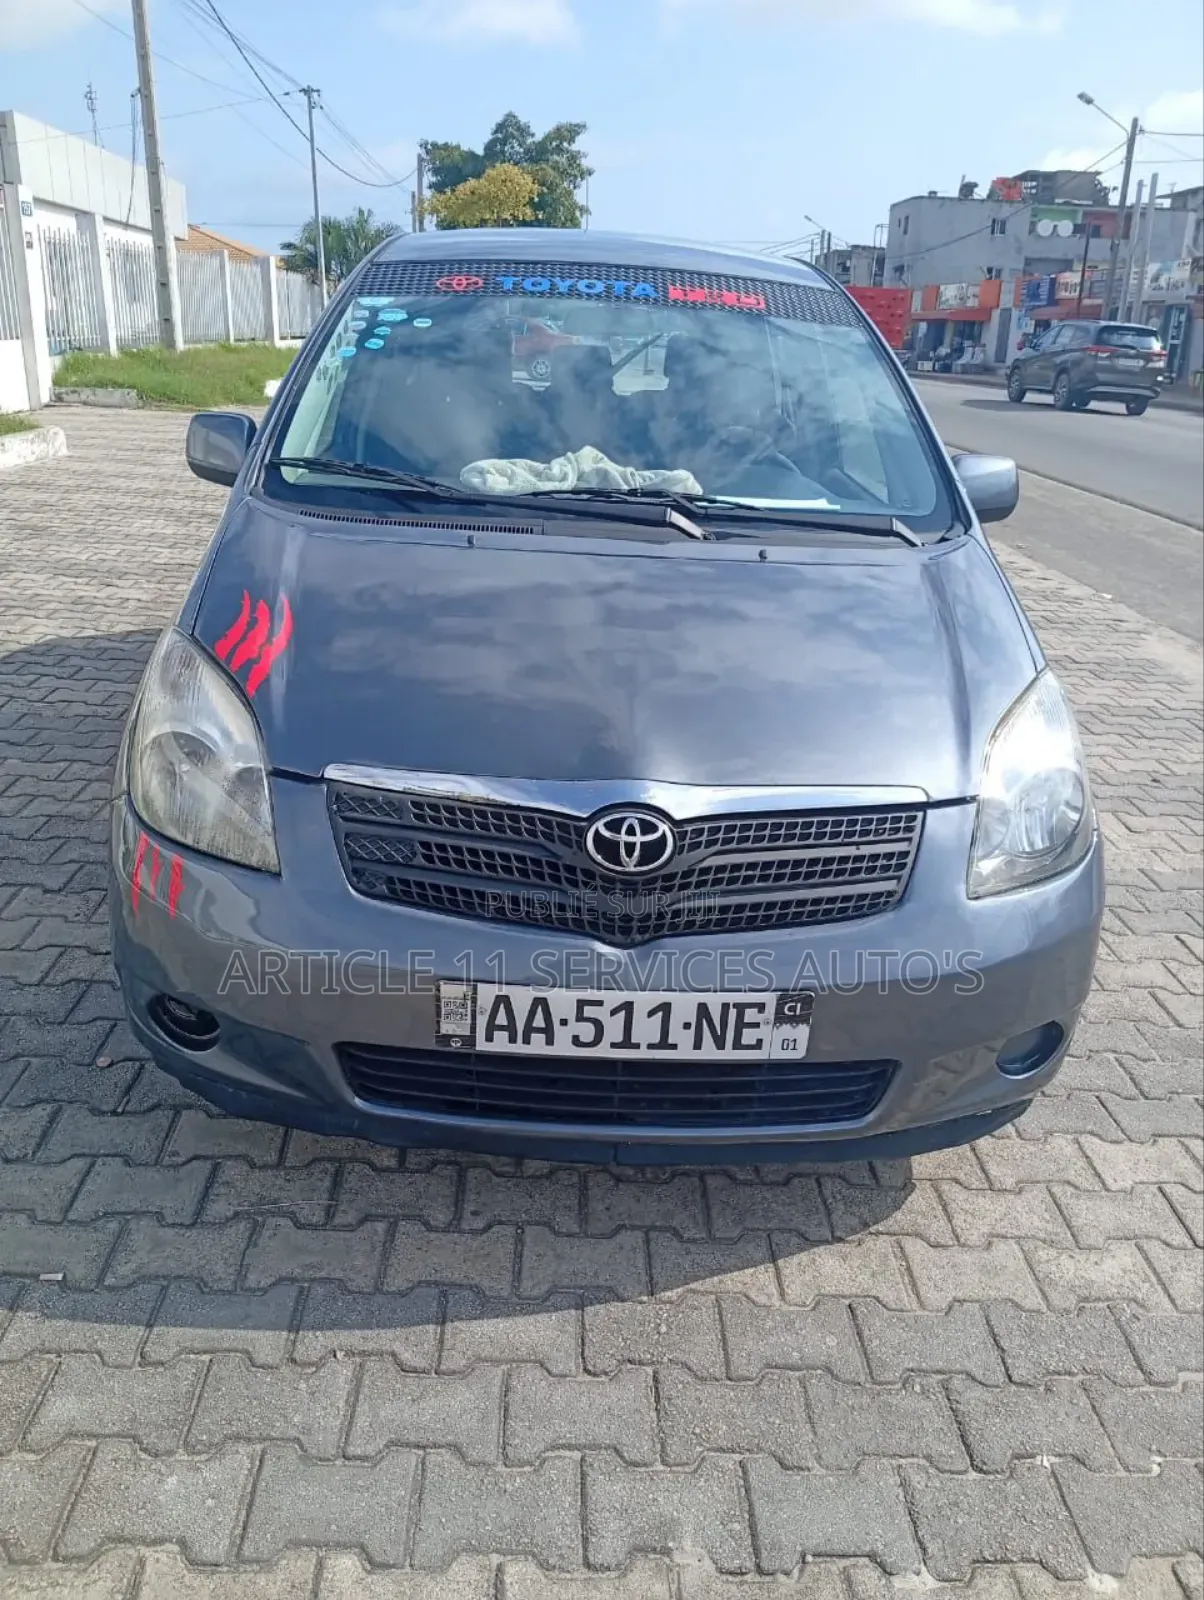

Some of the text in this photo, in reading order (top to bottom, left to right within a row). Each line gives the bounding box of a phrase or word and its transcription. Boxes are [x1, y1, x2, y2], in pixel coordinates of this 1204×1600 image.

[496, 276, 660, 297] TOYOTA
[784, 1002, 801, 1016] CI
[781, 1038, 798, 1051] 01
